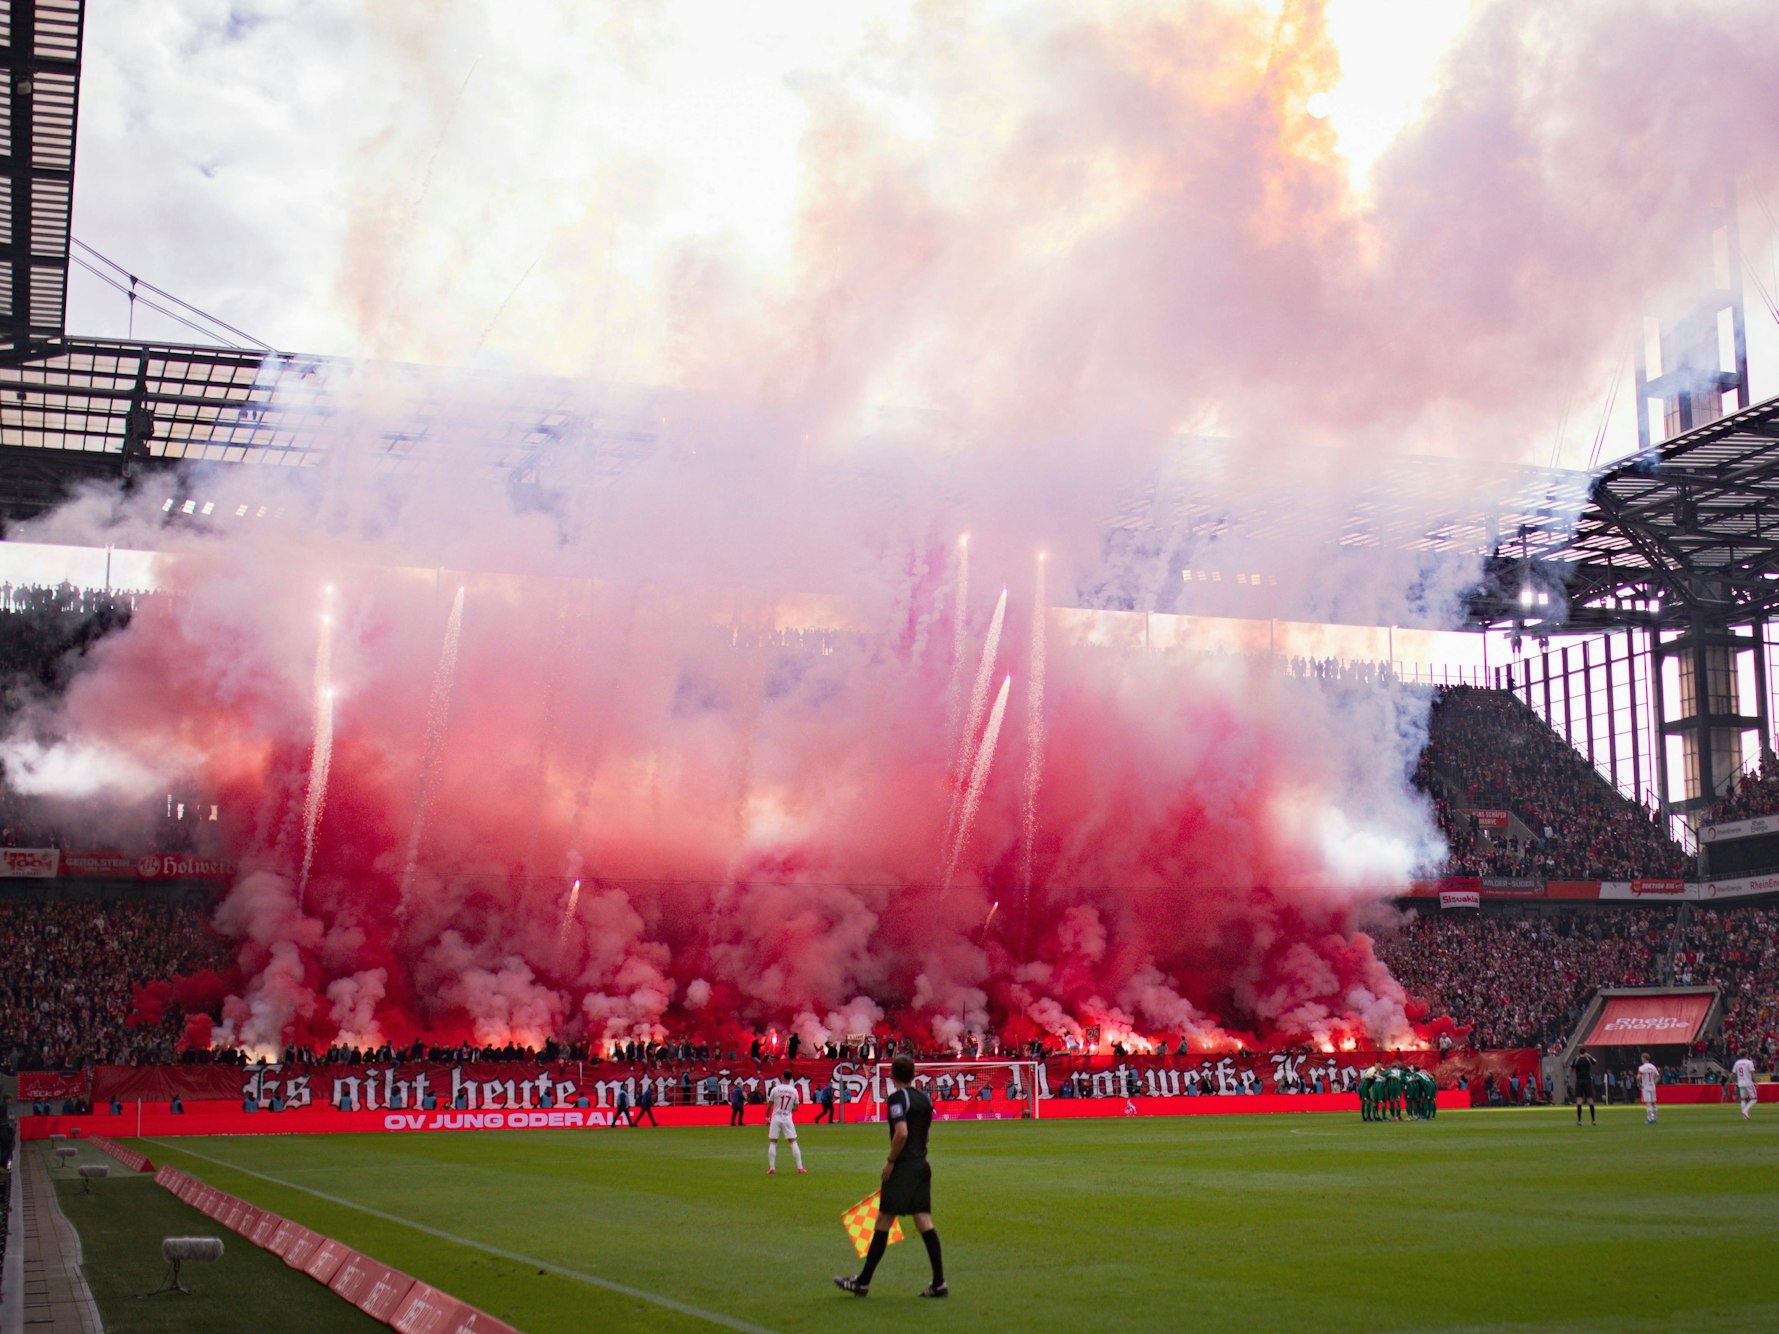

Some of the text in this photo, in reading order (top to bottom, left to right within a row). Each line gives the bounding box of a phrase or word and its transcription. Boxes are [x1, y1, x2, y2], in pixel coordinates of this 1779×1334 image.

[1604, 1021, 1690, 1030] Energie
[1616, 1016, 1679, 1026] Rhein
[242, 1064, 312, 1111] Es
[450, 1065, 577, 1110] heute
[780, 1095, 792, 1111] 17
[384, 1111, 634, 1130] OV JUNG ODER ALT
